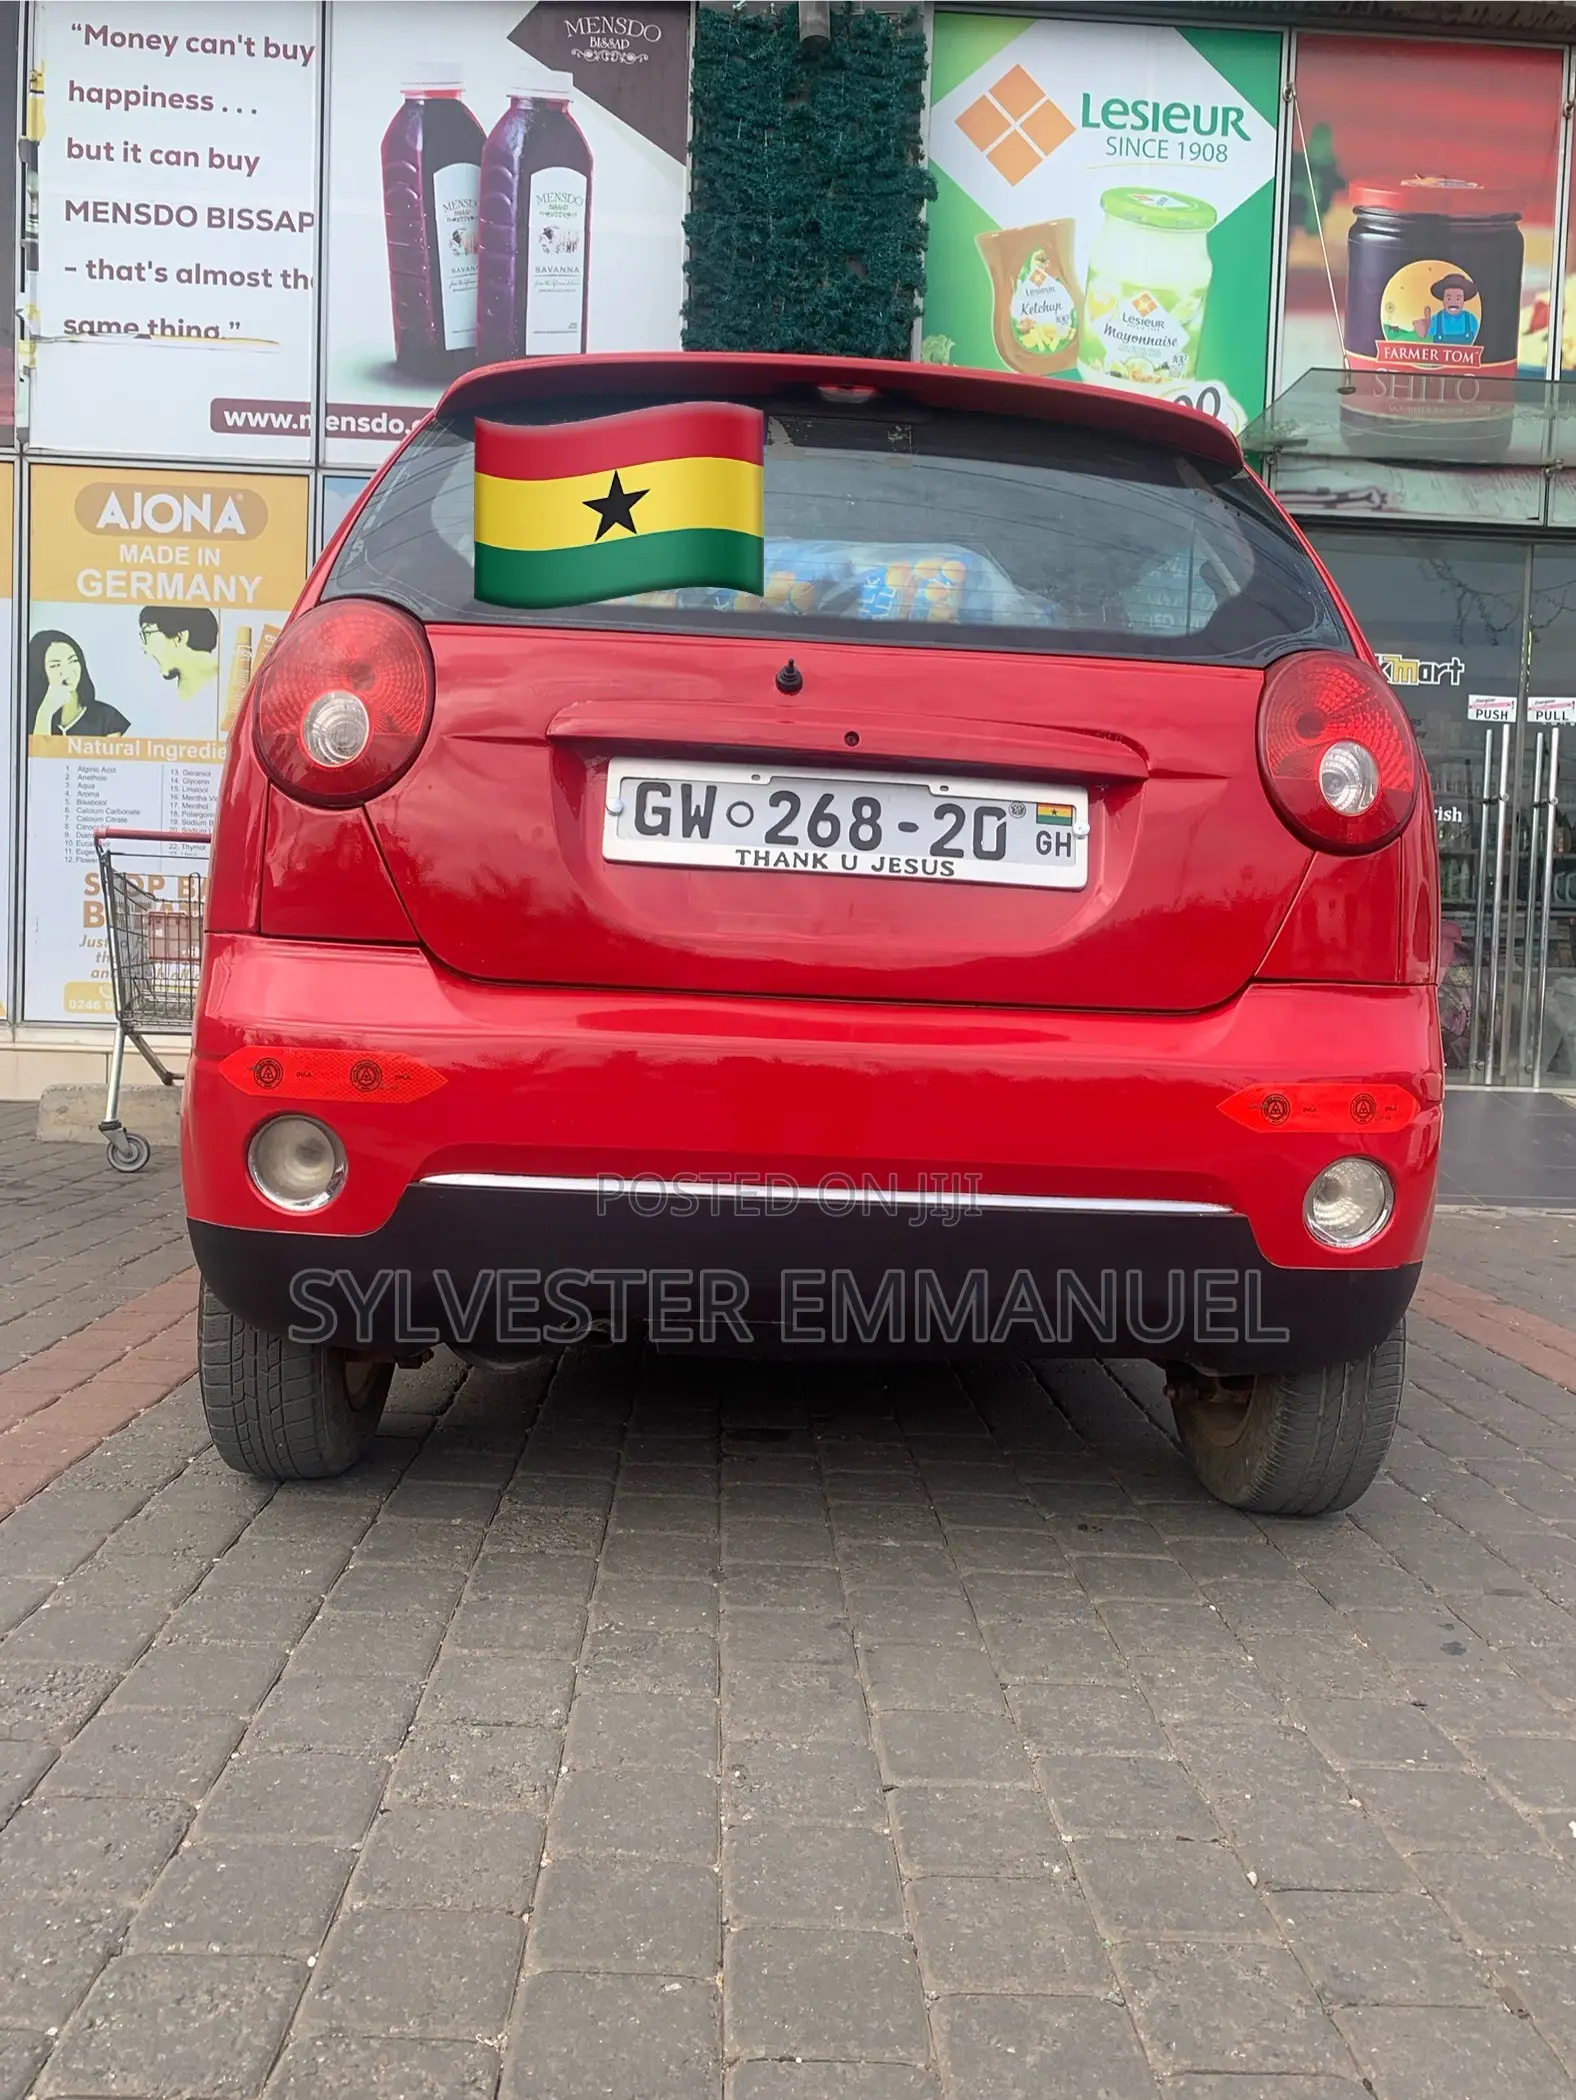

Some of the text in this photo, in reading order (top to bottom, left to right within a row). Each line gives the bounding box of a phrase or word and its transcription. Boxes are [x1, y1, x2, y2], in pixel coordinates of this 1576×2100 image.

[564, 16, 662, 42] MENSDO
[185, 34, 256, 57] can't
[264, 36, 316, 67] buy
[590, 36, 631, 50] BISSAP
[68, 80, 214, 112] happiness
[67, 137, 260, 177] but it can buy
[1106, 136, 1228, 162] SINCE 1908
[442, 199, 478, 213] MENSD
[535, 191, 584, 207] MENSDO
[65, 200, 315, 233] MENSDO BISSAP
[86, 258, 168, 283] that's
[175, 263, 273, 288] almost
[451, 264, 478, 275] SAVAN
[535, 265, 580, 275] SAVANNA
[1020, 300, 1063, 315] Ketchup
[63, 319, 139, 336] same
[1104, 323, 1178, 347] Mayonnaise
[1384, 346, 1439, 361] FARMER
[96, 491, 247, 534] AJONA
[120, 544, 220, 567] MADE IN
[77, 568, 263, 604] GERMANY
[1475, 709, 1509, 721] PUSH
[1536, 710, 1569, 721] PULL
[67, 738, 140, 756] Natural
[634, 781, 718, 839] GW
[1434, 806, 1463, 823] rish
[1036, 830, 1072, 858] GH
[735, 849, 955, 877] THANK U JESUS
